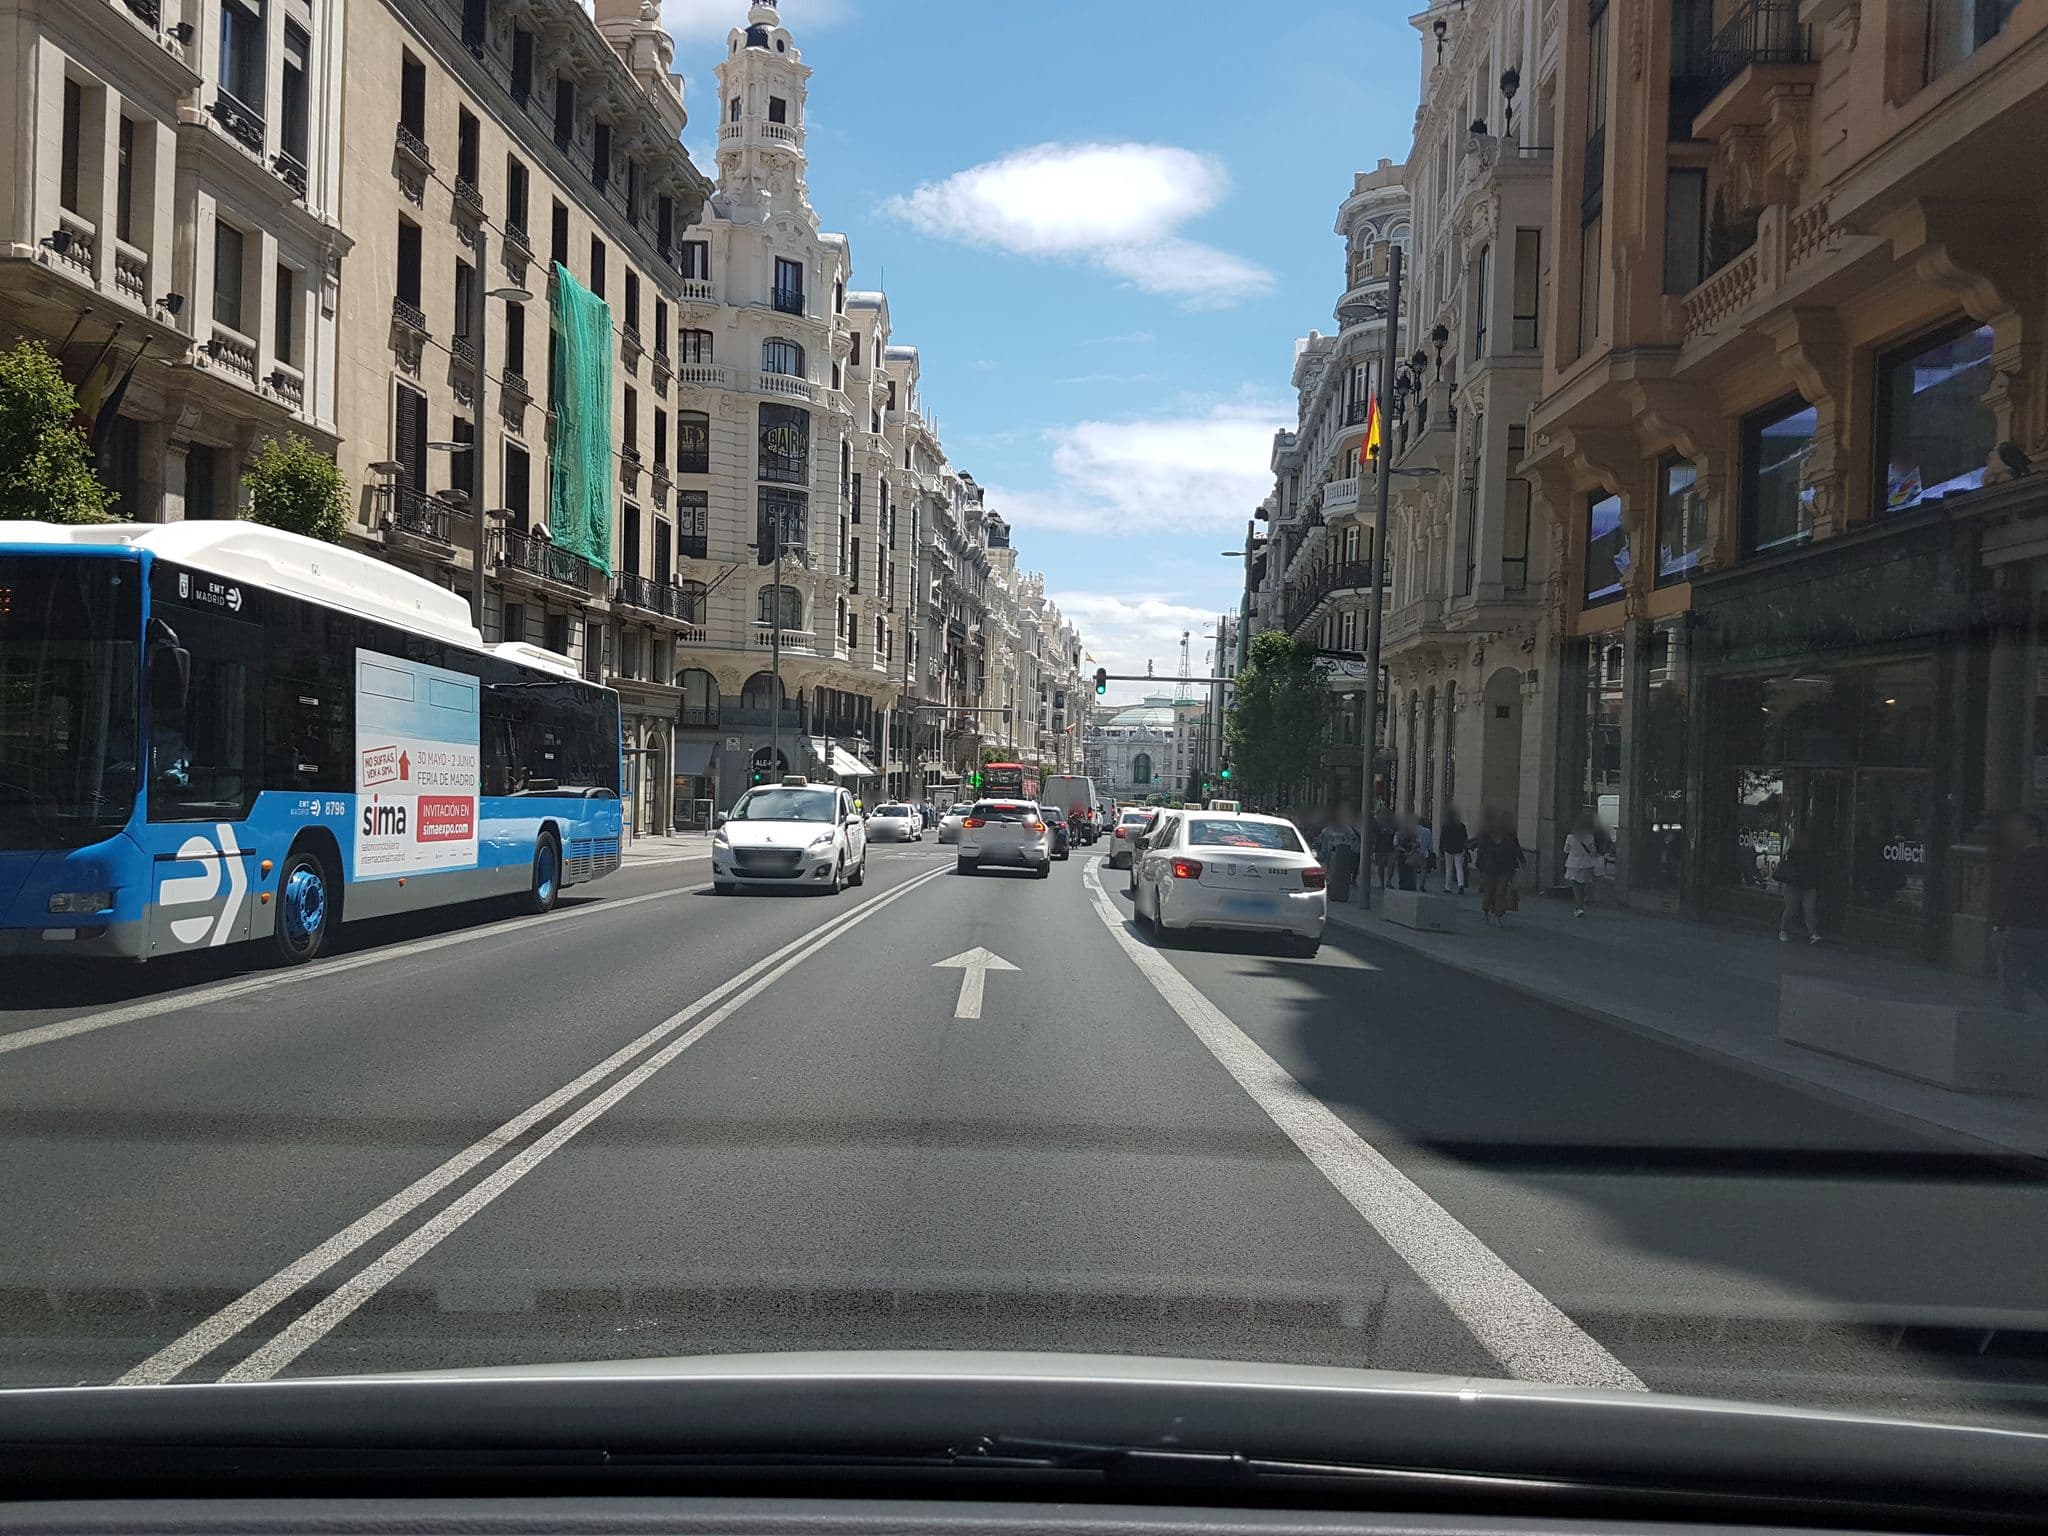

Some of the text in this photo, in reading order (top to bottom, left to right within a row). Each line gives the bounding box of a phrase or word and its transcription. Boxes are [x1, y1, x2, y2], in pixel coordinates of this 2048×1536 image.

[209, 582, 225, 595] EMT
[196, 590, 225, 606] MADRID
[365, 756, 373, 768] NO
[417, 751, 426, 765] 30
[428, 752, 447, 765] MAYO
[452, 754, 456, 767] 2
[457, 755, 475, 768] JUNIO
[755, 759, 781, 767] ALE-HP
[366, 768, 377, 779] VEN
[417, 771, 475, 787] FERIA DE MADRID
[325, 801, 345, 816] 8796
[362, 793, 406, 836] sima
[423, 801, 470, 818] INVITACIÓN EN
[423, 822, 469, 837] simaexpo.com
[1883, 841, 1925, 863] collect
